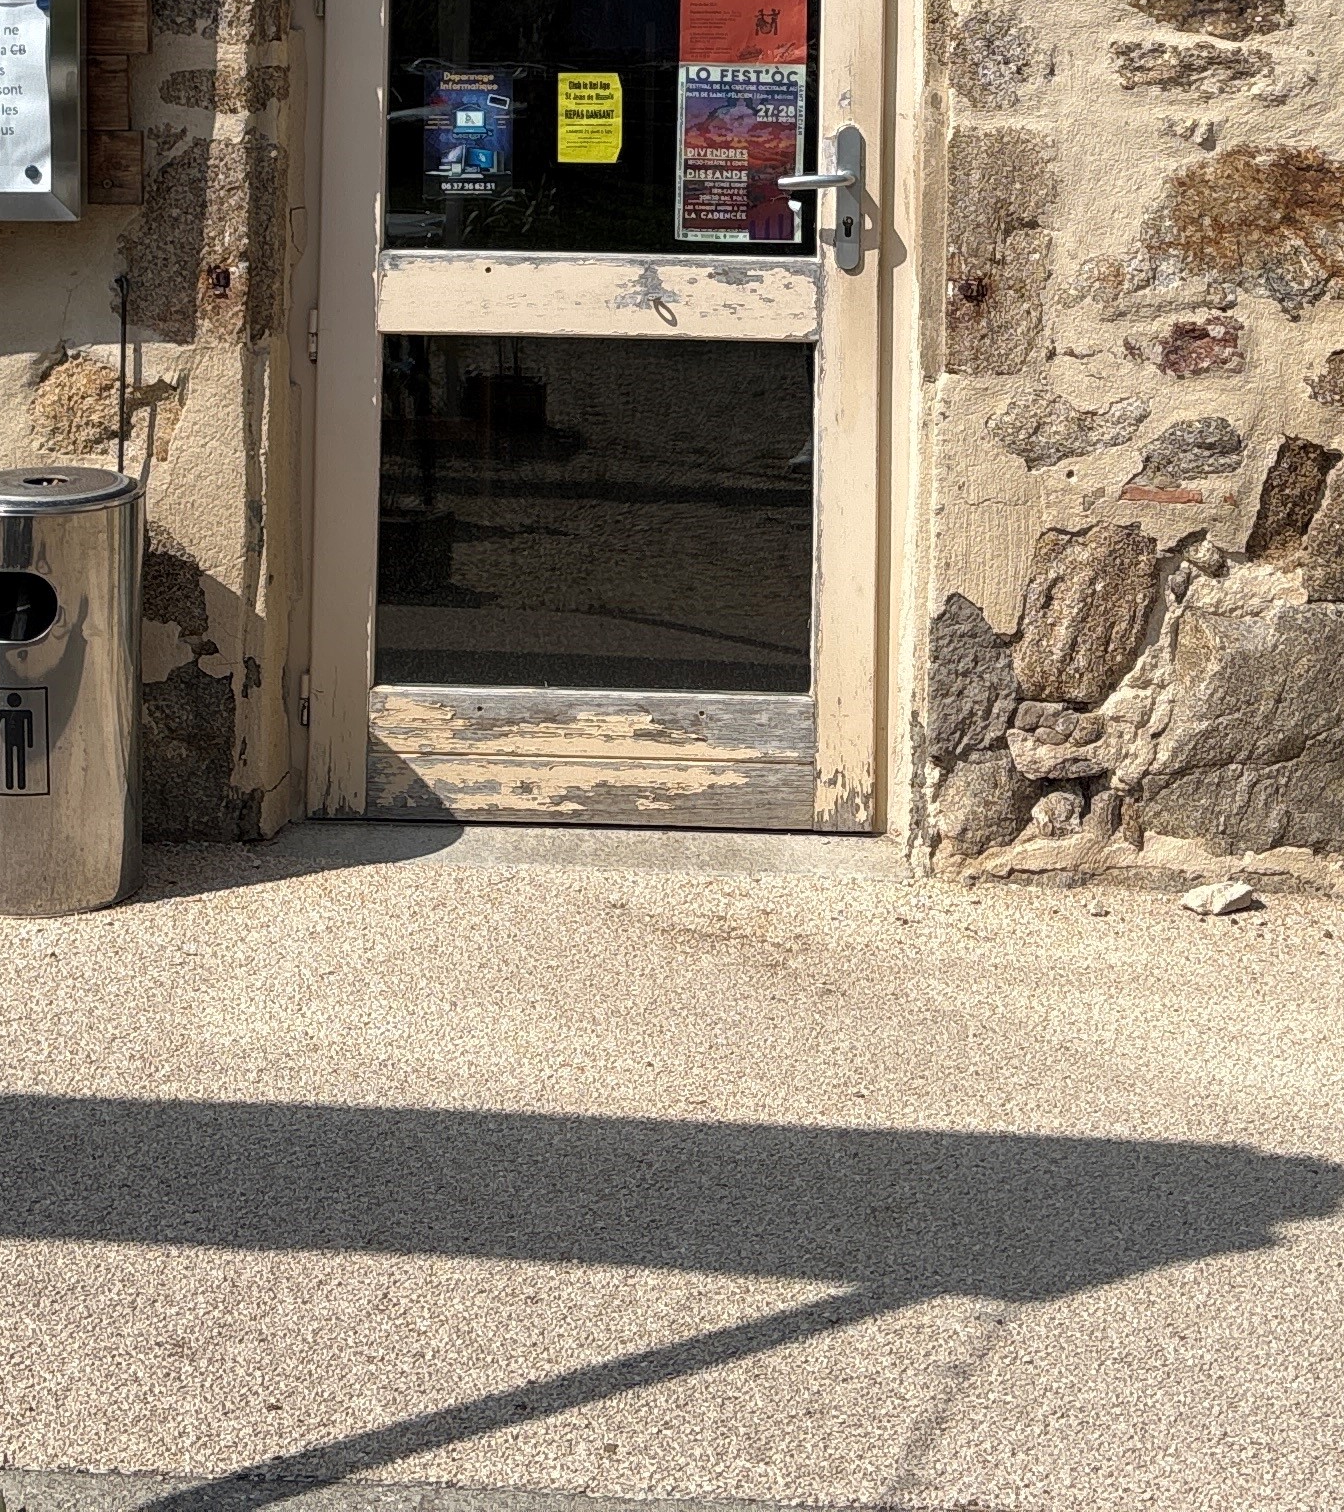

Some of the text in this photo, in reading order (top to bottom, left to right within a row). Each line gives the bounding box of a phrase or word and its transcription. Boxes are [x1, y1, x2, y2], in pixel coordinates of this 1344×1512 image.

[3, 26, 20, 36] ne
[685, 67, 711, 82] LO
[1, 103, 19, 116] les
[686, 169, 749, 180] DISSANDE
[684, 211, 696, 219] LA
